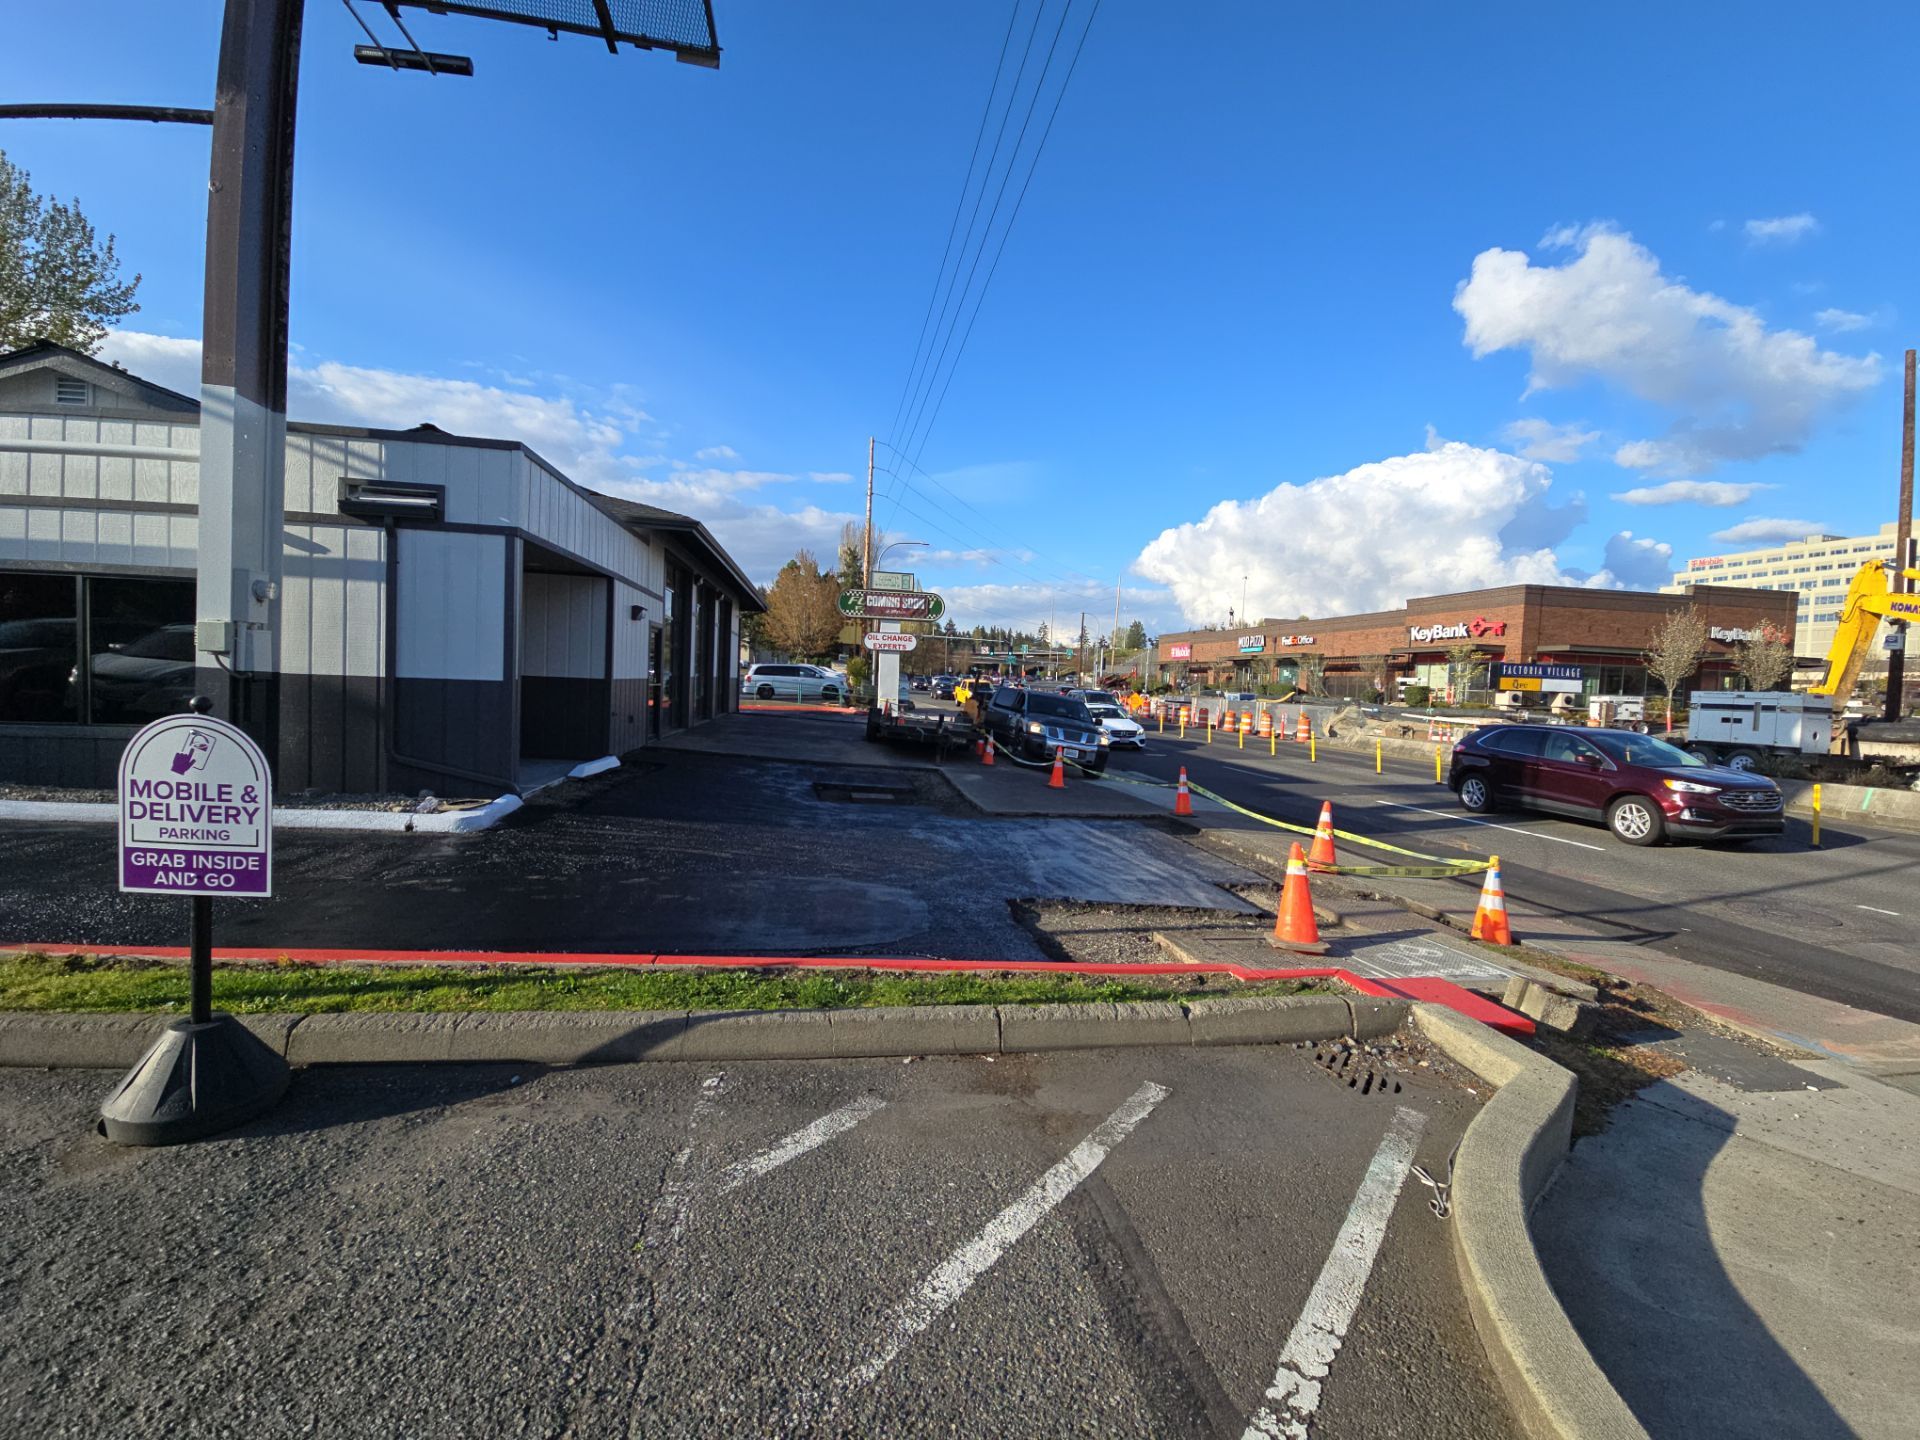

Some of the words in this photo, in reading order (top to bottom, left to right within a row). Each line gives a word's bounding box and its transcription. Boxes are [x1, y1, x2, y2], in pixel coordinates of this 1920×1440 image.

[867, 595, 900, 608] COMING
[902, 597, 925, 609] SOON
[1891, 602, 1920, 614] KOMA
[883, 634, 913, 642] CHANGE
[1411, 622, 1468, 642] KeyBank
[1250, 635, 1265, 647] PIZZA
[1282, 634, 1297, 645] FedEx
[1297, 635, 1314, 644] Office
[1503, 665, 1543, 676] FACTORIA
[1547, 667, 1581, 678] VILLAGE
[130, 779, 233, 802] MOBILE
[240, 784, 258, 804] &
[129, 800, 260, 825] DELIVERY
[159, 827, 230, 841] PARKING
[131, 851, 186, 868] GRAB
[193, 856, 260, 871] INSIDE
[154, 870, 198, 886] AND
[204, 873, 235, 887] GO
